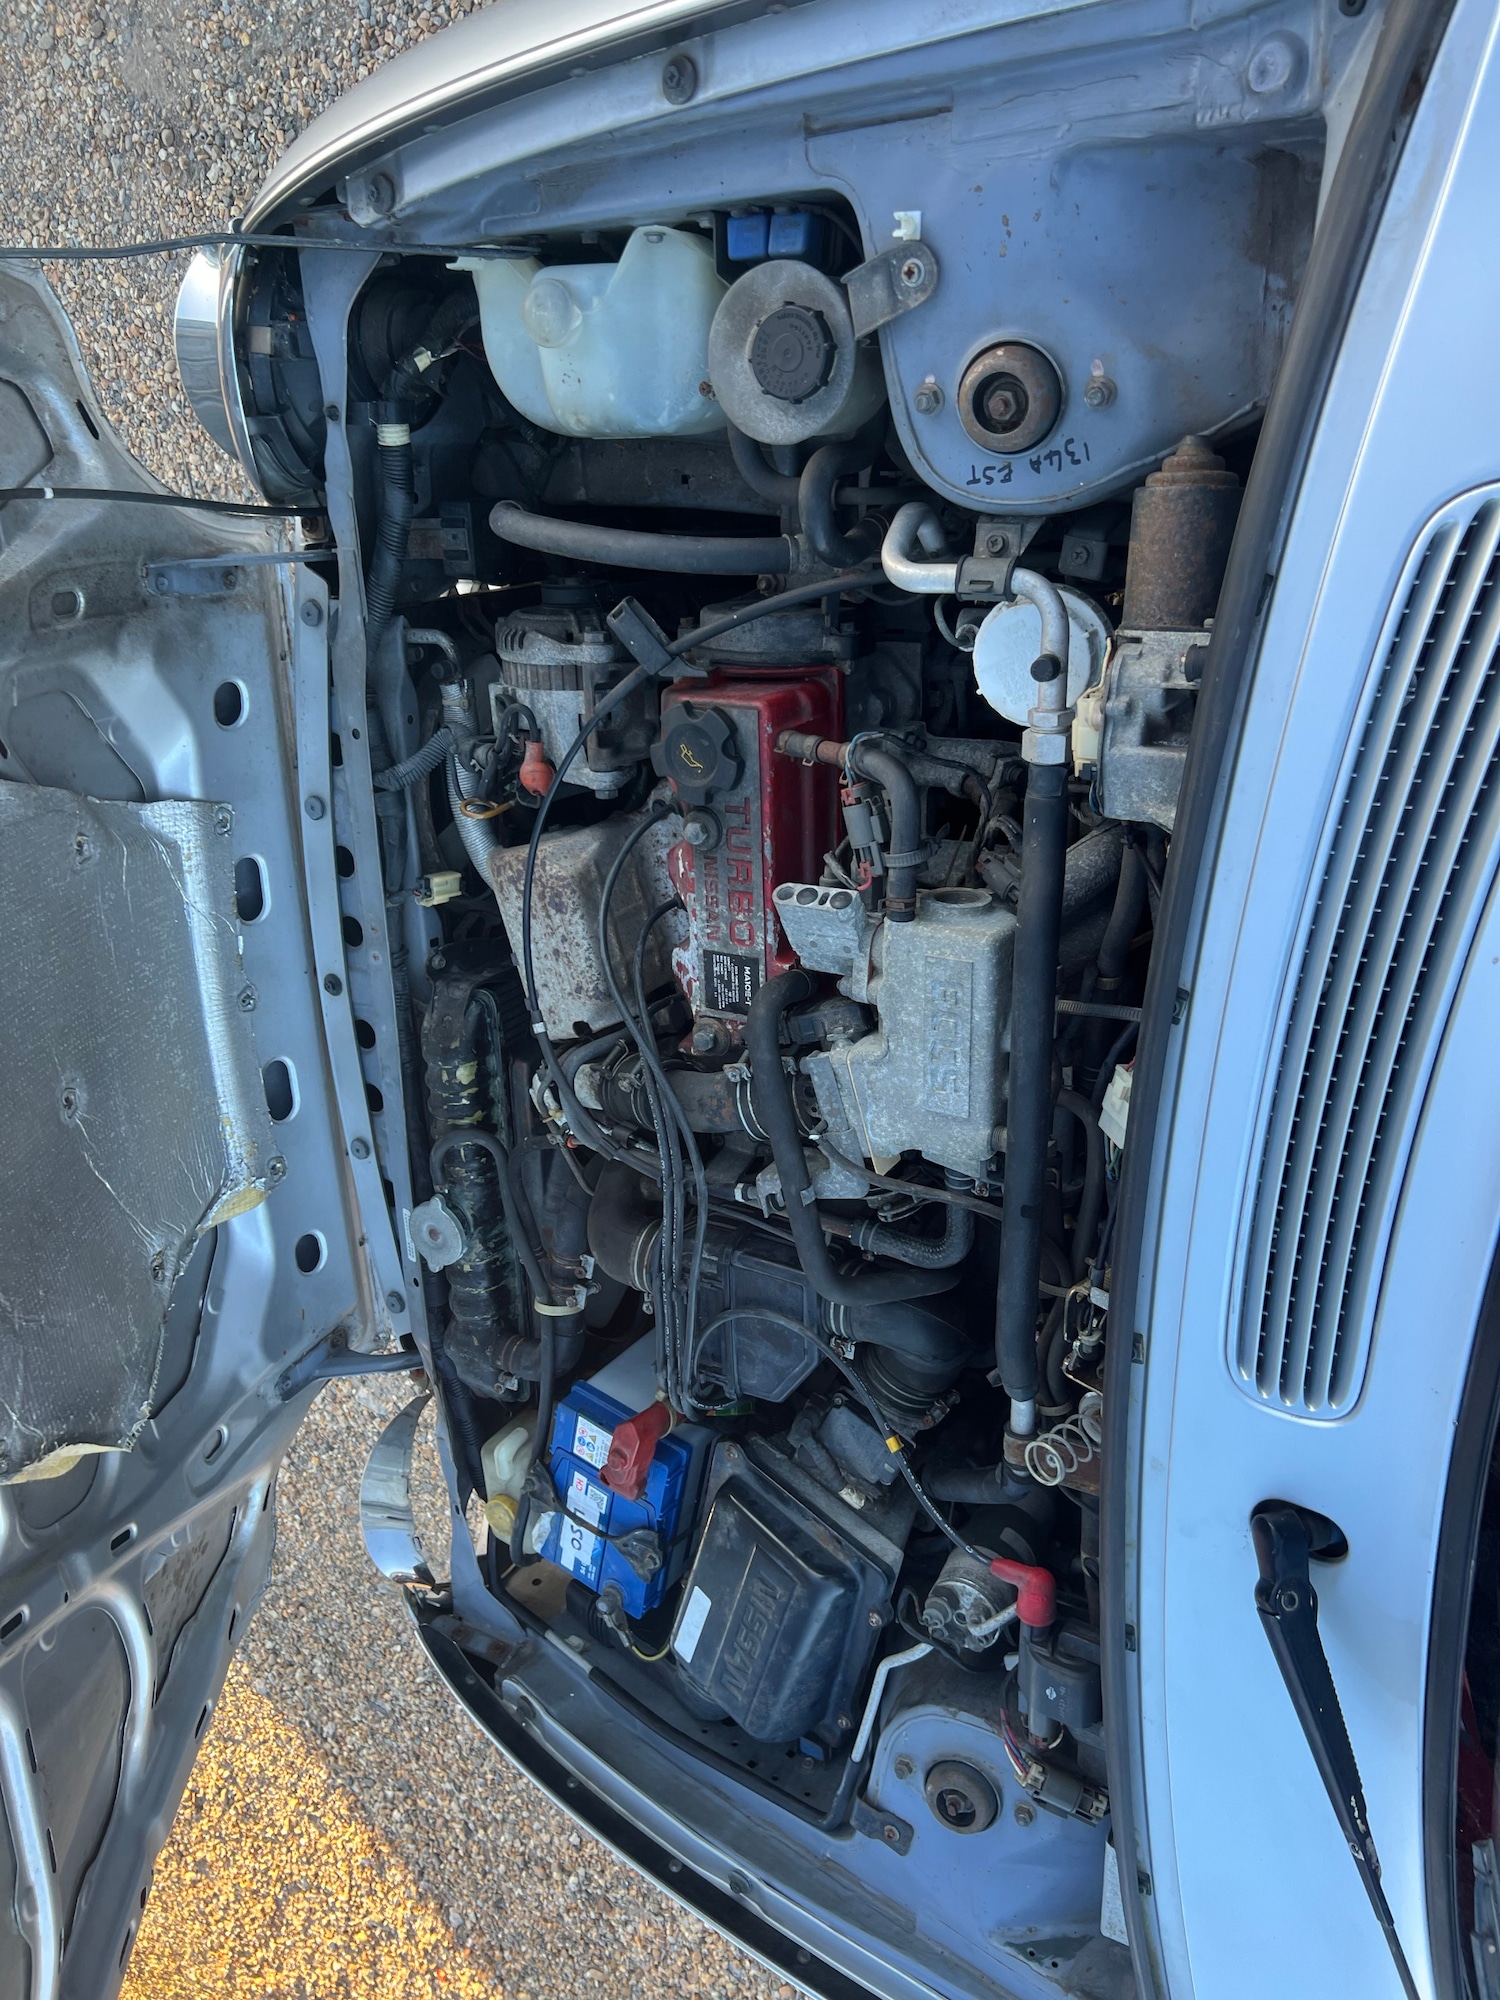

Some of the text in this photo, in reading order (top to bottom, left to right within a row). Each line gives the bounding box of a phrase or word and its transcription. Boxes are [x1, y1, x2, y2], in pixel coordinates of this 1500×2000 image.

[704, 855, 721, 942] NISSAN
[725, 797, 756, 948] TURBO
[720, 1571, 781, 1701] NISSAN
